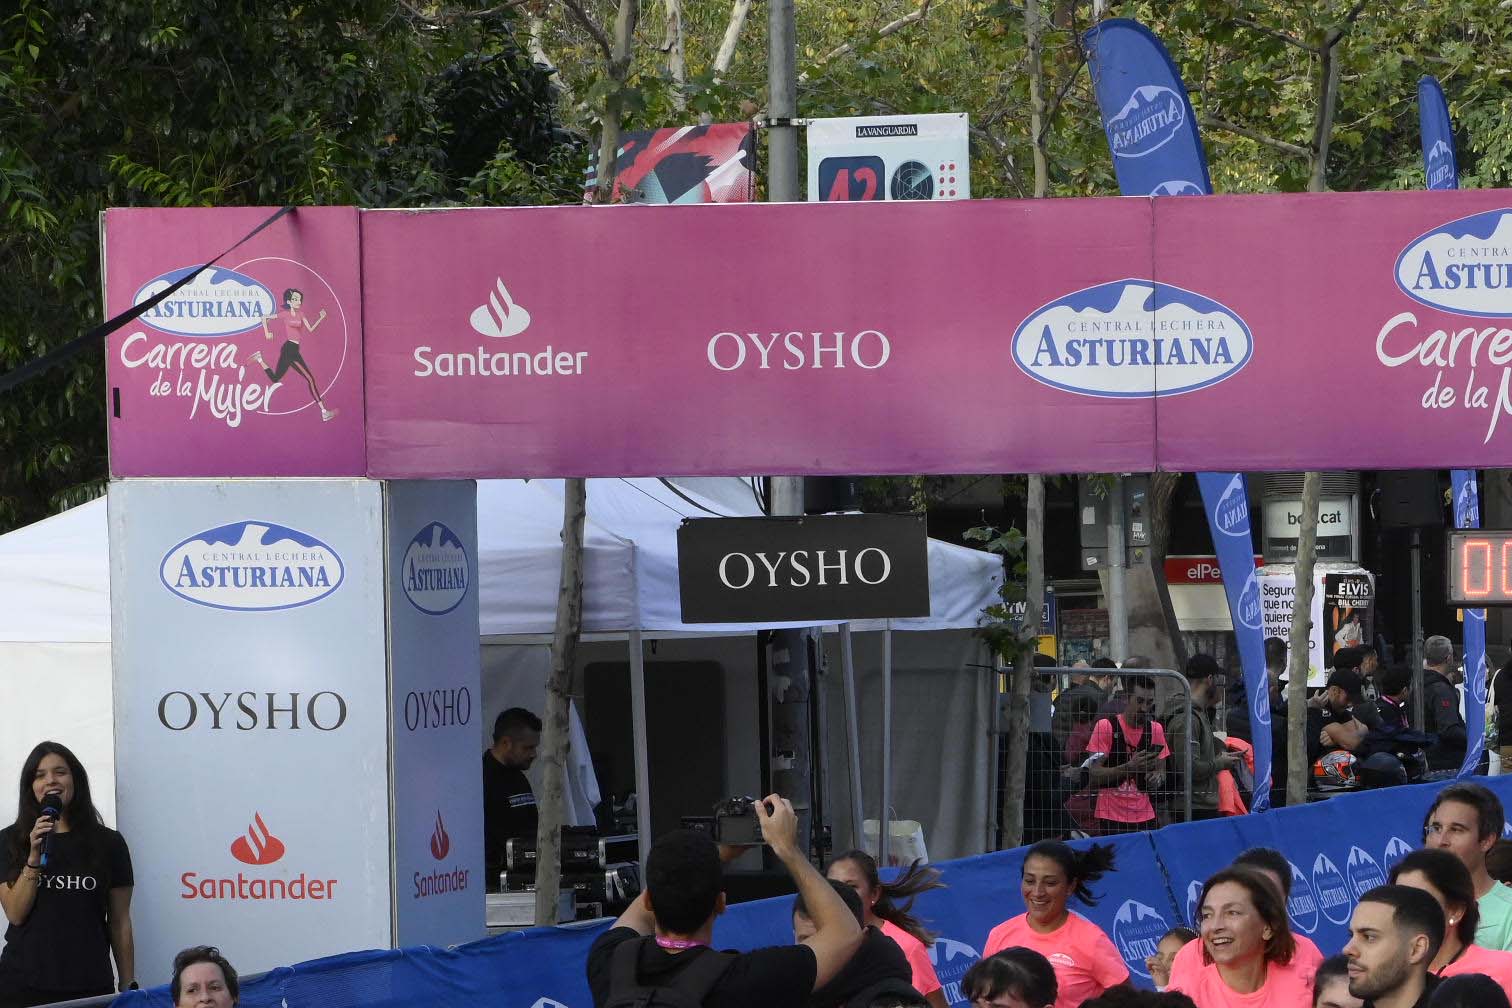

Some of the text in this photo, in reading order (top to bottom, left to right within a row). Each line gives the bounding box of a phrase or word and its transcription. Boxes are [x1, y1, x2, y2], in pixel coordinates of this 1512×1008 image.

[1066, 319, 1227, 332] CENTRAL LECHERA
[121, 331, 237, 371] Carrera
[414, 345, 588, 377] Santander
[707, 329, 891, 371] OYSHO
[1029, 325, 1234, 368] ASTURIANA
[150, 369, 192, 398] de la
[190, 364, 283, 428] Mujer
[1422, 369, 1488, 409] de la
[175, 554, 331, 589] ASTURIANA
[202, 551, 325, 562] CENTRAL LECHERA
[408, 556, 465, 592] ASTURIANA
[718, 547, 891, 589] OYSHO
[1187, 564, 1220, 580] elPe
[1264, 600, 1280, 610] que
[1338, 582, 1369, 596] ELVIS
[1264, 612, 1292, 625] quiere
[158, 691, 347, 731] OYSHO
[404, 686, 471, 732] OYSHO
[37, 875, 97, 891] YSHO
[181, 872, 338, 900] Santander
[413, 865, 469, 900] Santander
